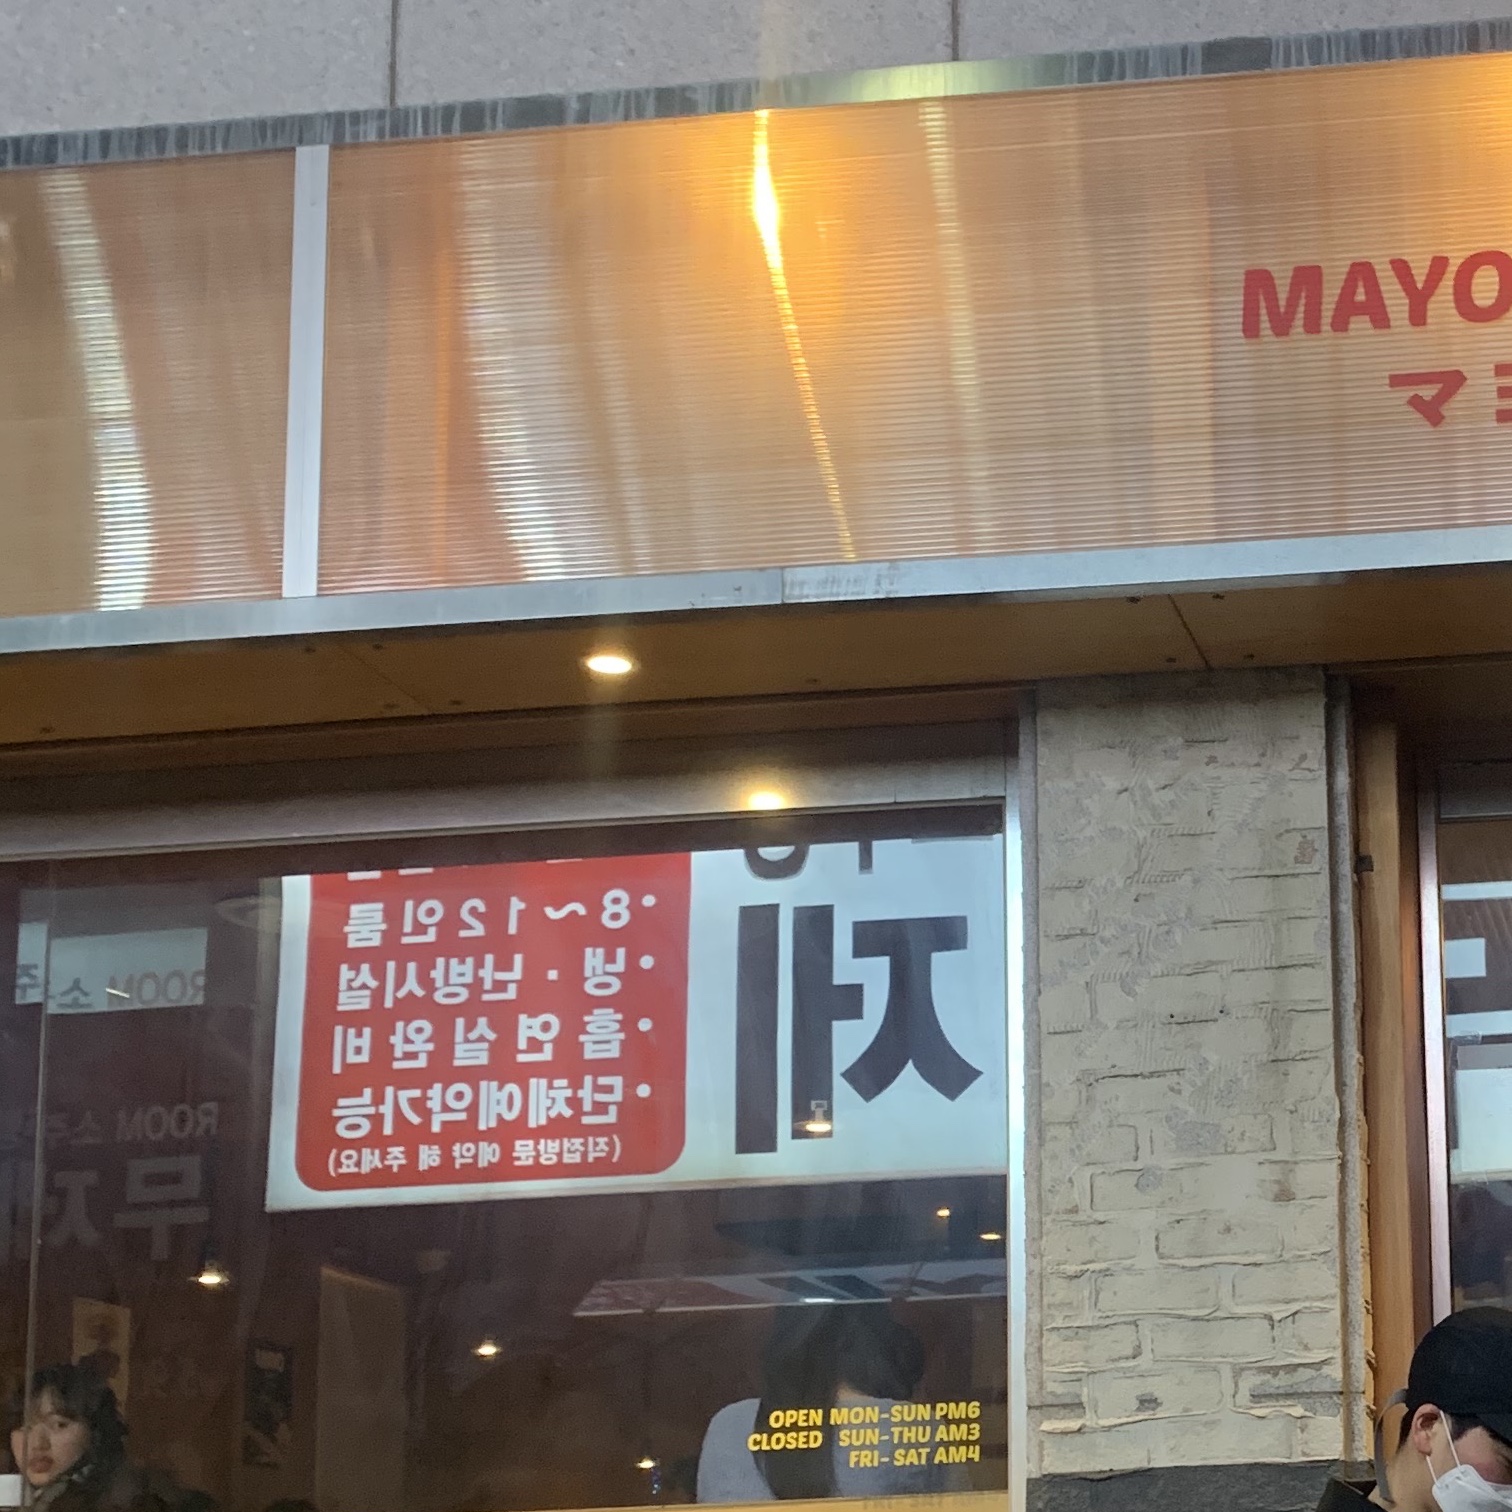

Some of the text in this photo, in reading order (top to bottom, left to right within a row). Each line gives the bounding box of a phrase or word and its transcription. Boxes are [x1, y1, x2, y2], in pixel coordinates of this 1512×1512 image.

[769, 1408, 823, 1429] OPEN
[934, 1401, 981, 1421] PM6
[747, 1430, 823, 1451] CLOSED
[934, 1423, 981, 1442] AM3
[934, 1445, 981, 1464] AM4
